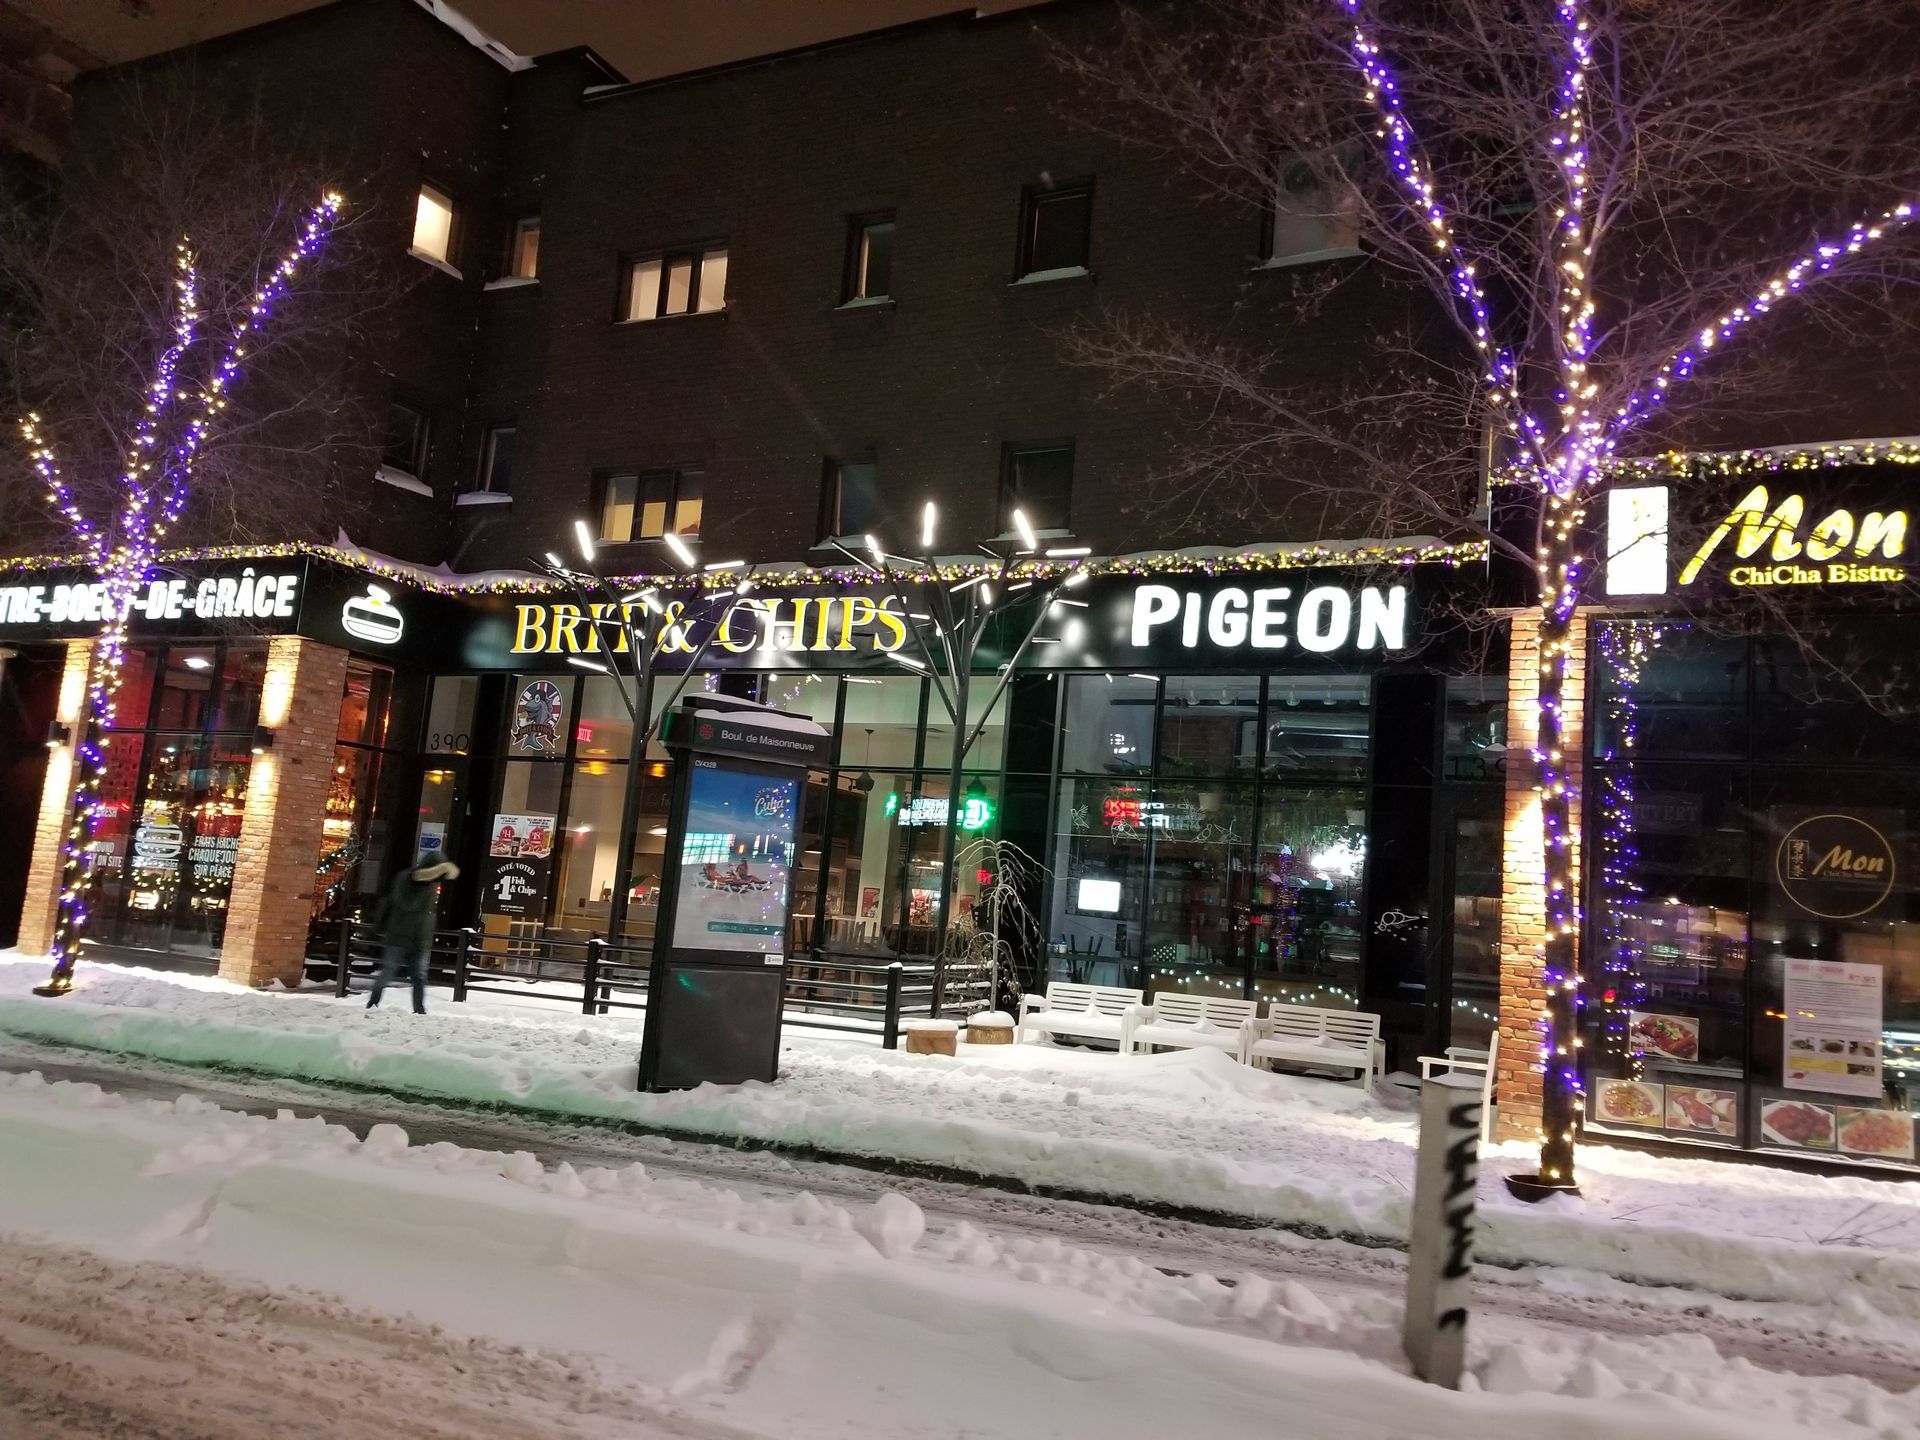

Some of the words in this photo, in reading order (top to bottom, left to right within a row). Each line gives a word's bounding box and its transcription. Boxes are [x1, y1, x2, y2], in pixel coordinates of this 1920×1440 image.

[1679, 485, 1908, 585] Mon
[1729, 565, 1822, 586] ChiCha
[510, 603, 648, 654] BRIT
[656, 600, 698, 654] &
[718, 595, 908, 652] CHIPS
[1131, 584, 1406, 652] PIGEON
[431, 733, 469, 751] 390
[721, 729, 744, 741] Boul.
[746, 734, 758, 743] de
[760, 735, 815, 752] Maisonneuve
[755, 796, 784, 816] Cuba
[98, 854, 107, 867] ON
[108, 856, 123, 868] SITE
[188, 848, 219, 863] CHAQUE
[1812, 845, 1884, 875] Mon
[193, 864, 208, 877] SUR
[209, 865, 233, 879] PLACE
[511, 876, 526, 885] Fish
[510, 885, 516, 893] &
[517, 885, 537, 896] Chips
